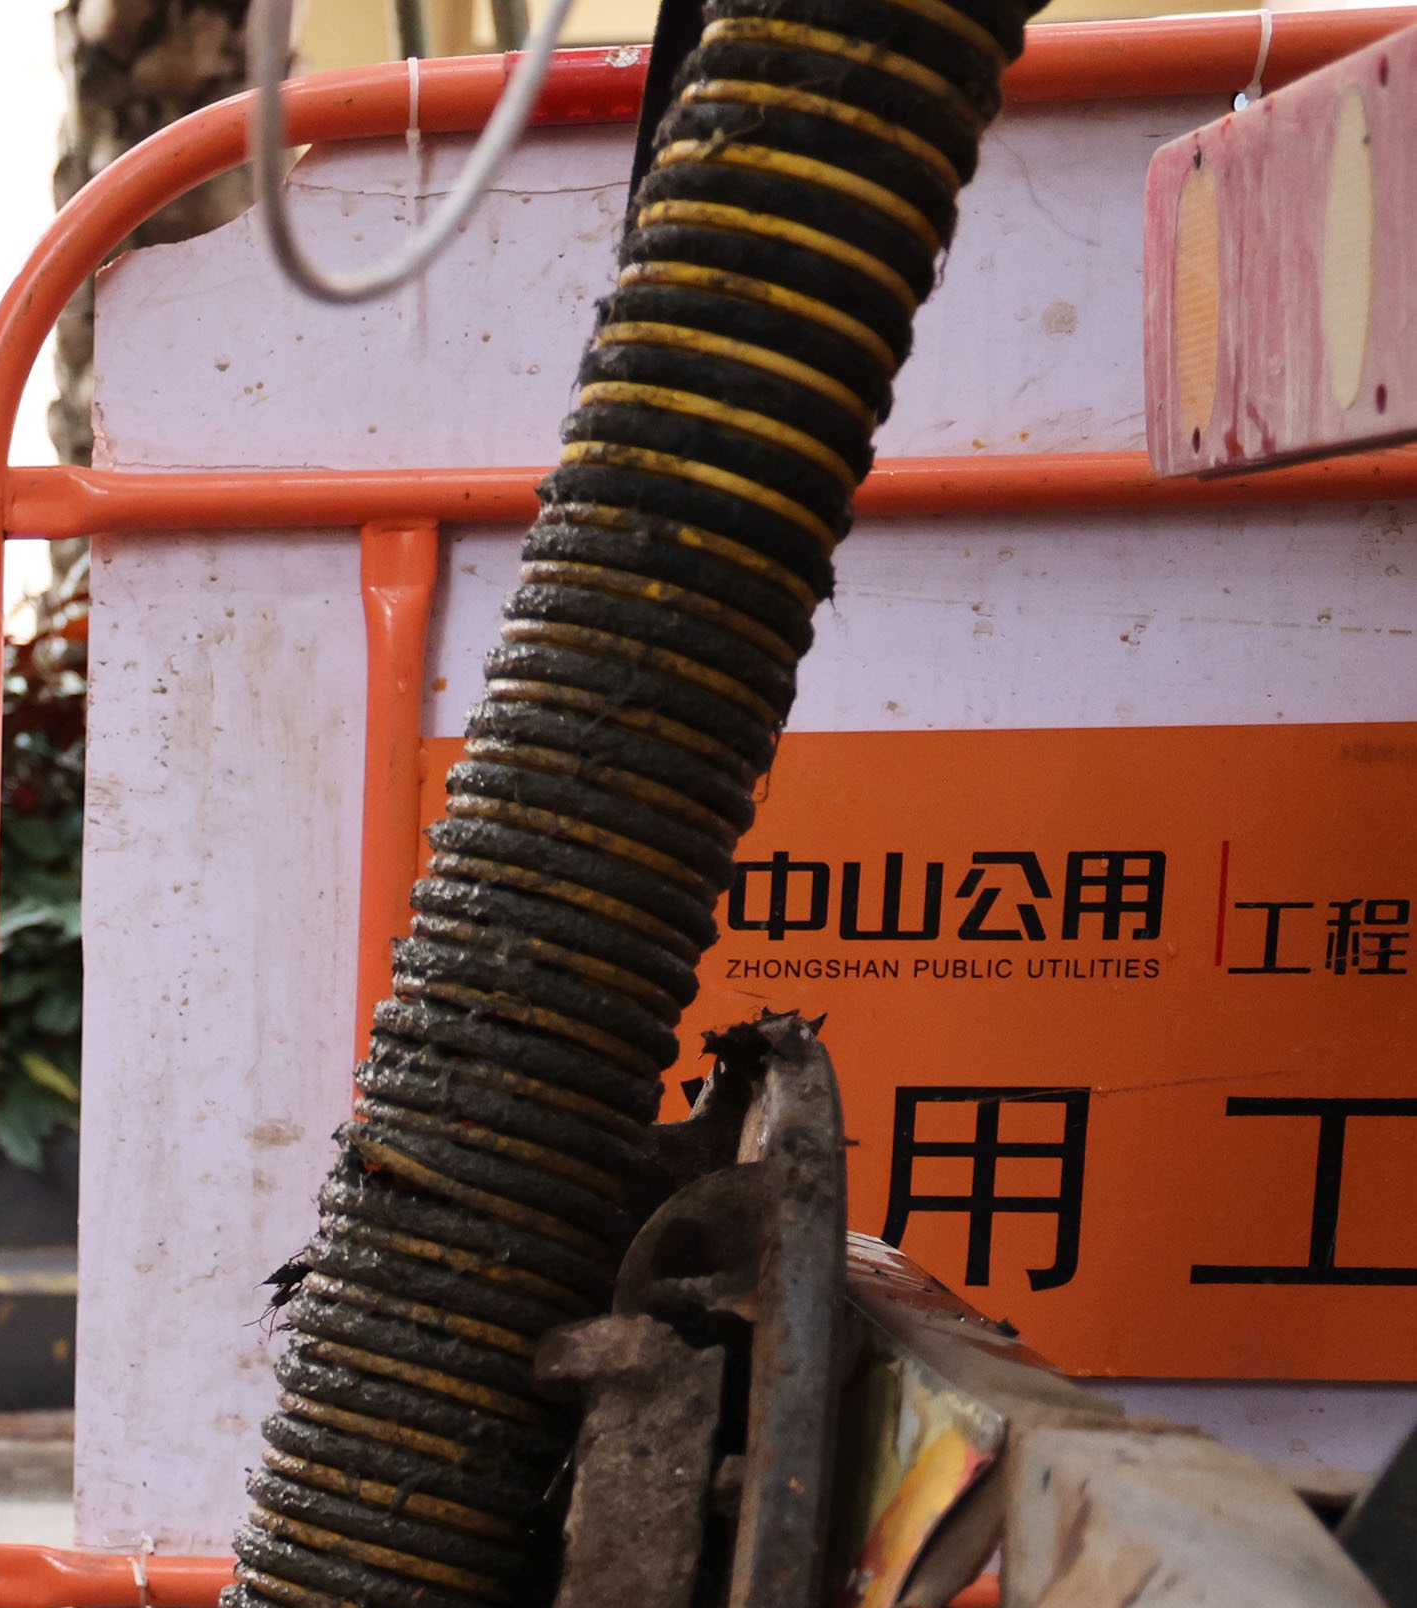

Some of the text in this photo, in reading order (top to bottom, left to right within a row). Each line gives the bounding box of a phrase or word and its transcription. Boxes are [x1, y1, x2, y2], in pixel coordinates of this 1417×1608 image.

[728, 850, 1412, 976] 中山公用 工程
[726, 958, 1161, 979] ZHONGSHAN PUBLIC UTILITIES
